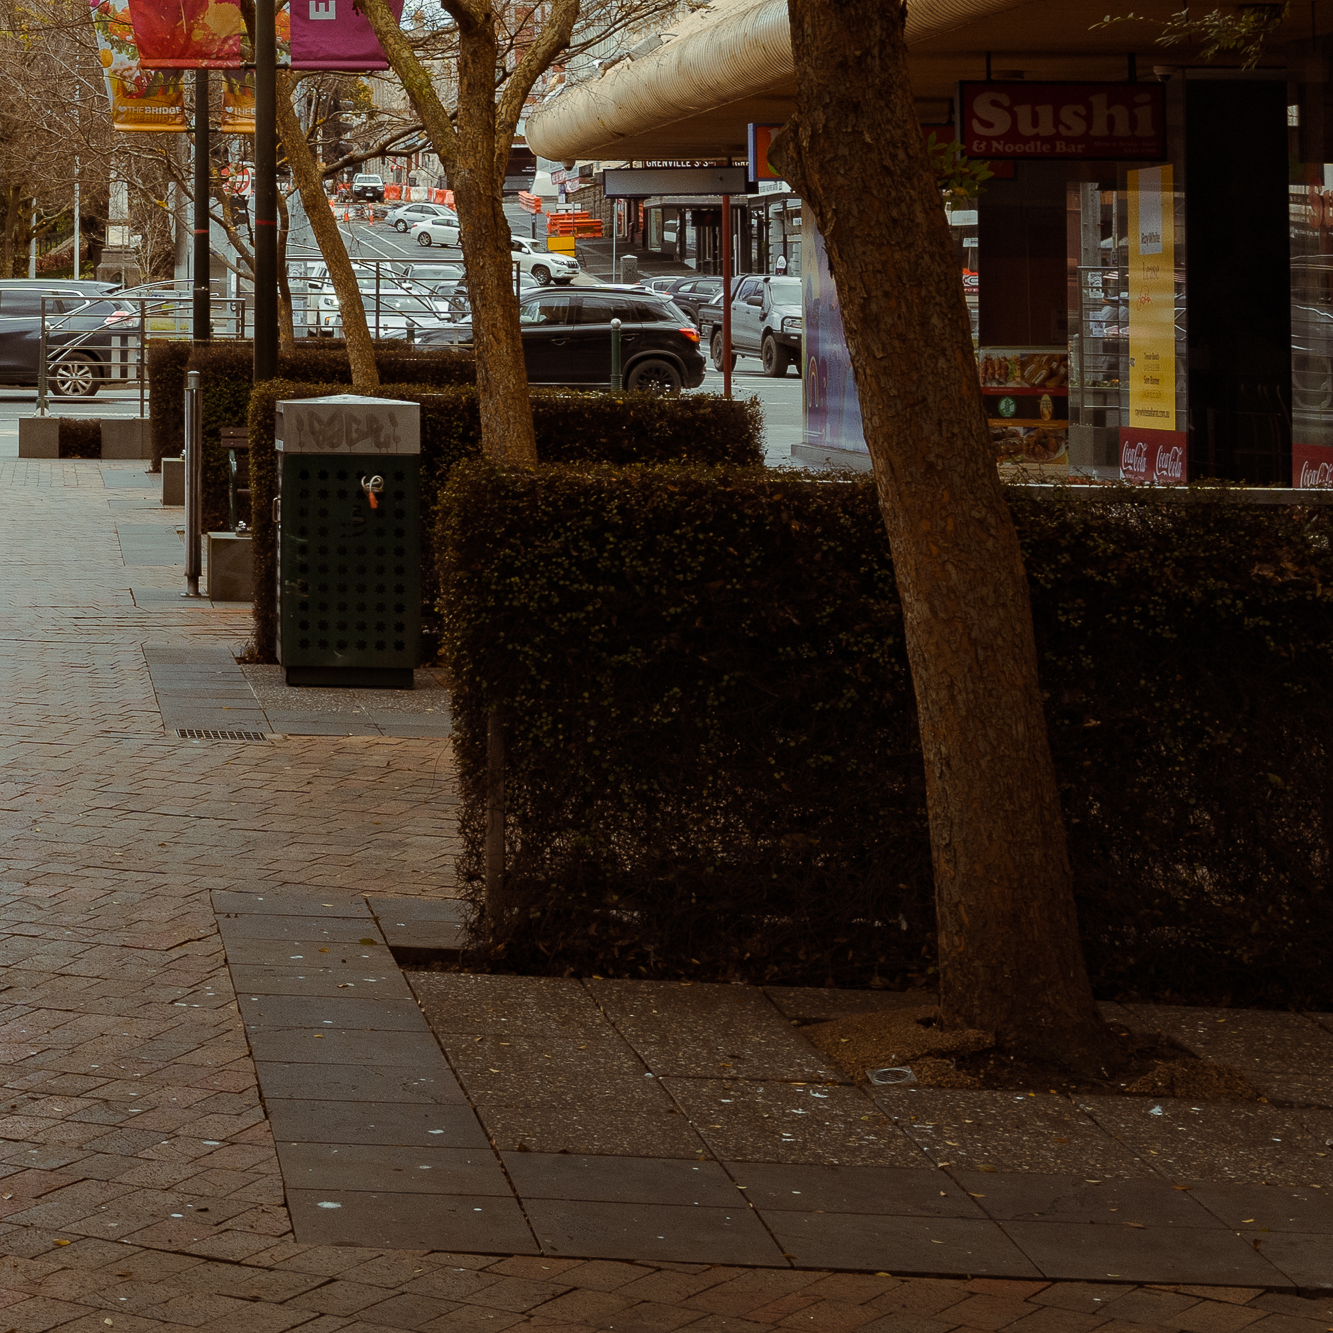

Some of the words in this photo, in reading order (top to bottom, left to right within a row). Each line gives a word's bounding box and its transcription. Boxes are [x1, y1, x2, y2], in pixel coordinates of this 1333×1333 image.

[145, 106, 182, 115] BRIDGE
[971, 91, 1156, 138] Sushi
[971, 140, 987, 153] &
[991, 140, 1051, 154] Noodle
[1055, 140, 1086, 154] Bar
